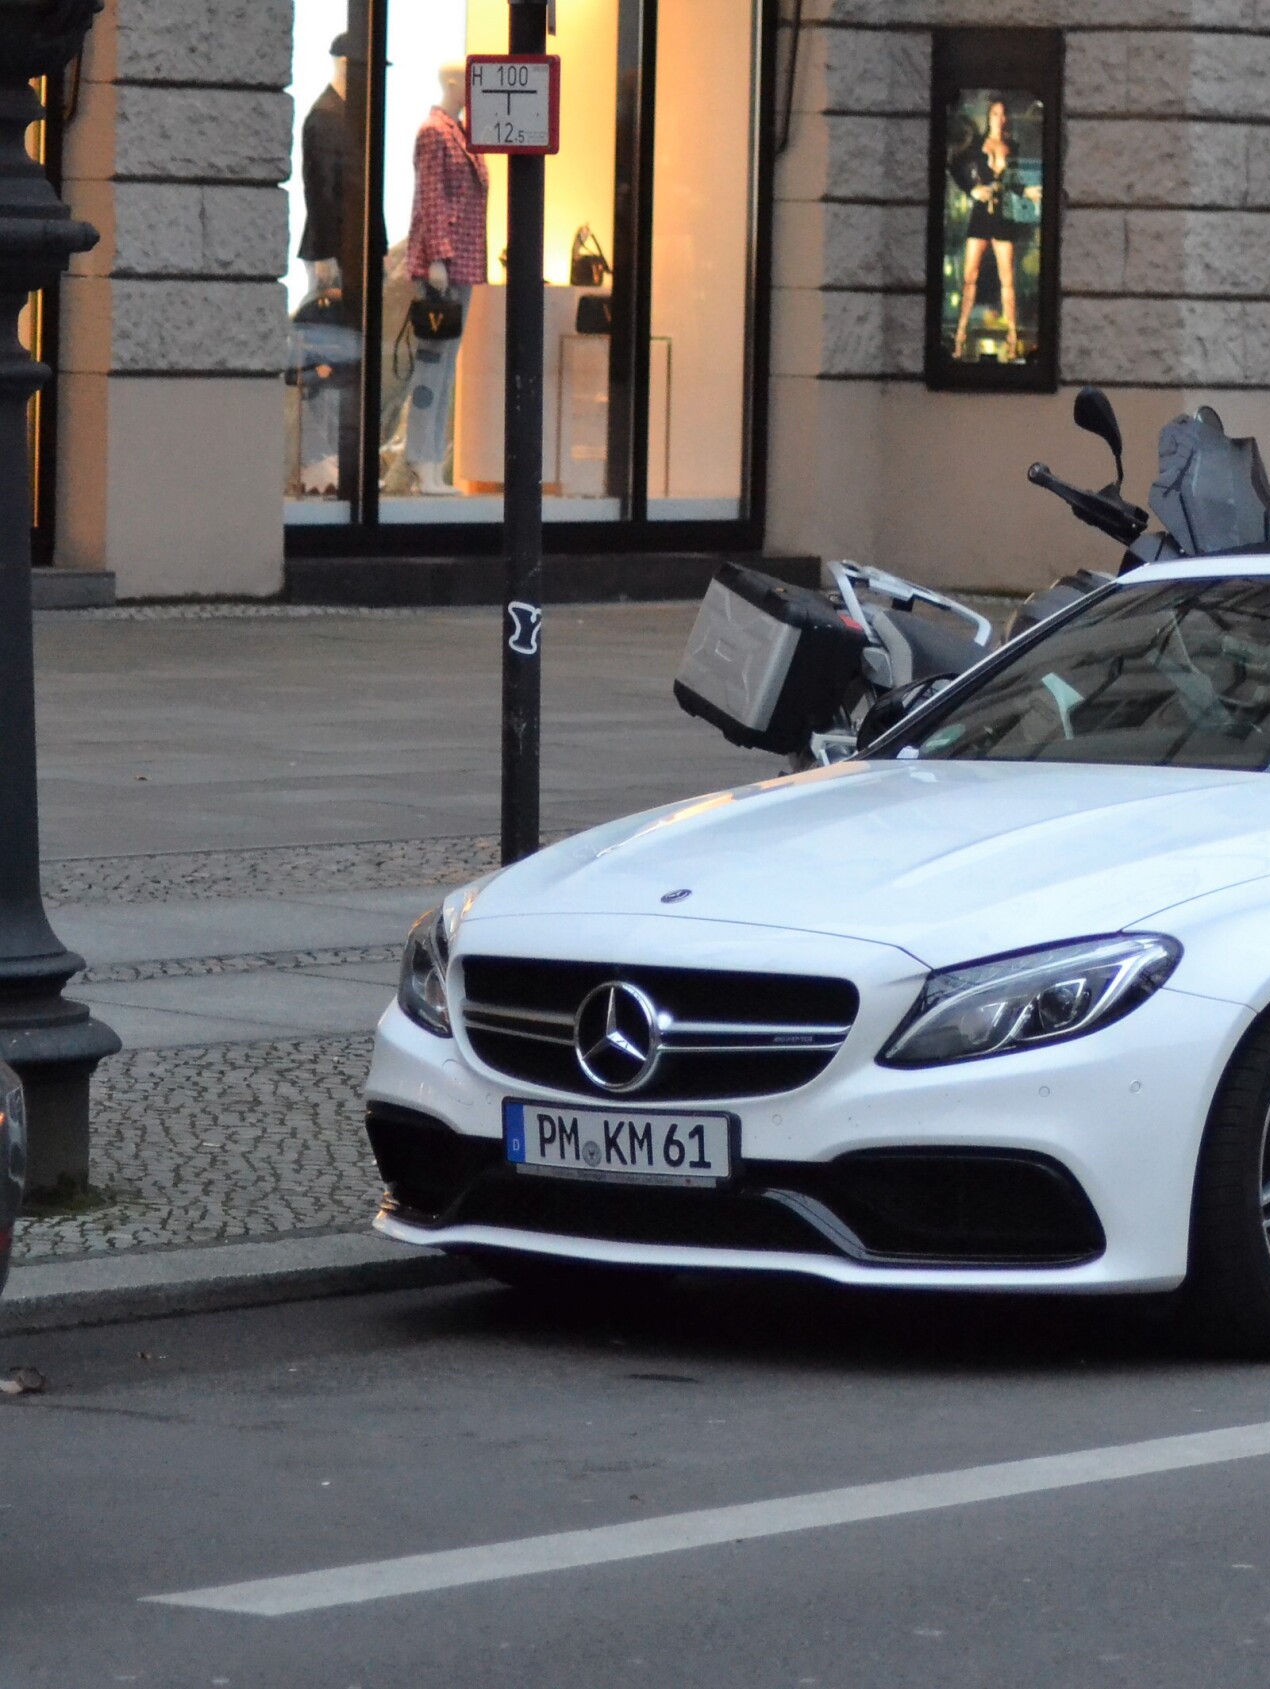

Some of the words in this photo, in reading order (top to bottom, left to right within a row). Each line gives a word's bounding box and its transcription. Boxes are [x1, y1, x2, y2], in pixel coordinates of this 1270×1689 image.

[472, 65, 483, 86] H
[497, 65, 528, 86] 100
[512, 1138, 520, 1151] D
[537, 1113, 580, 1160] PM
